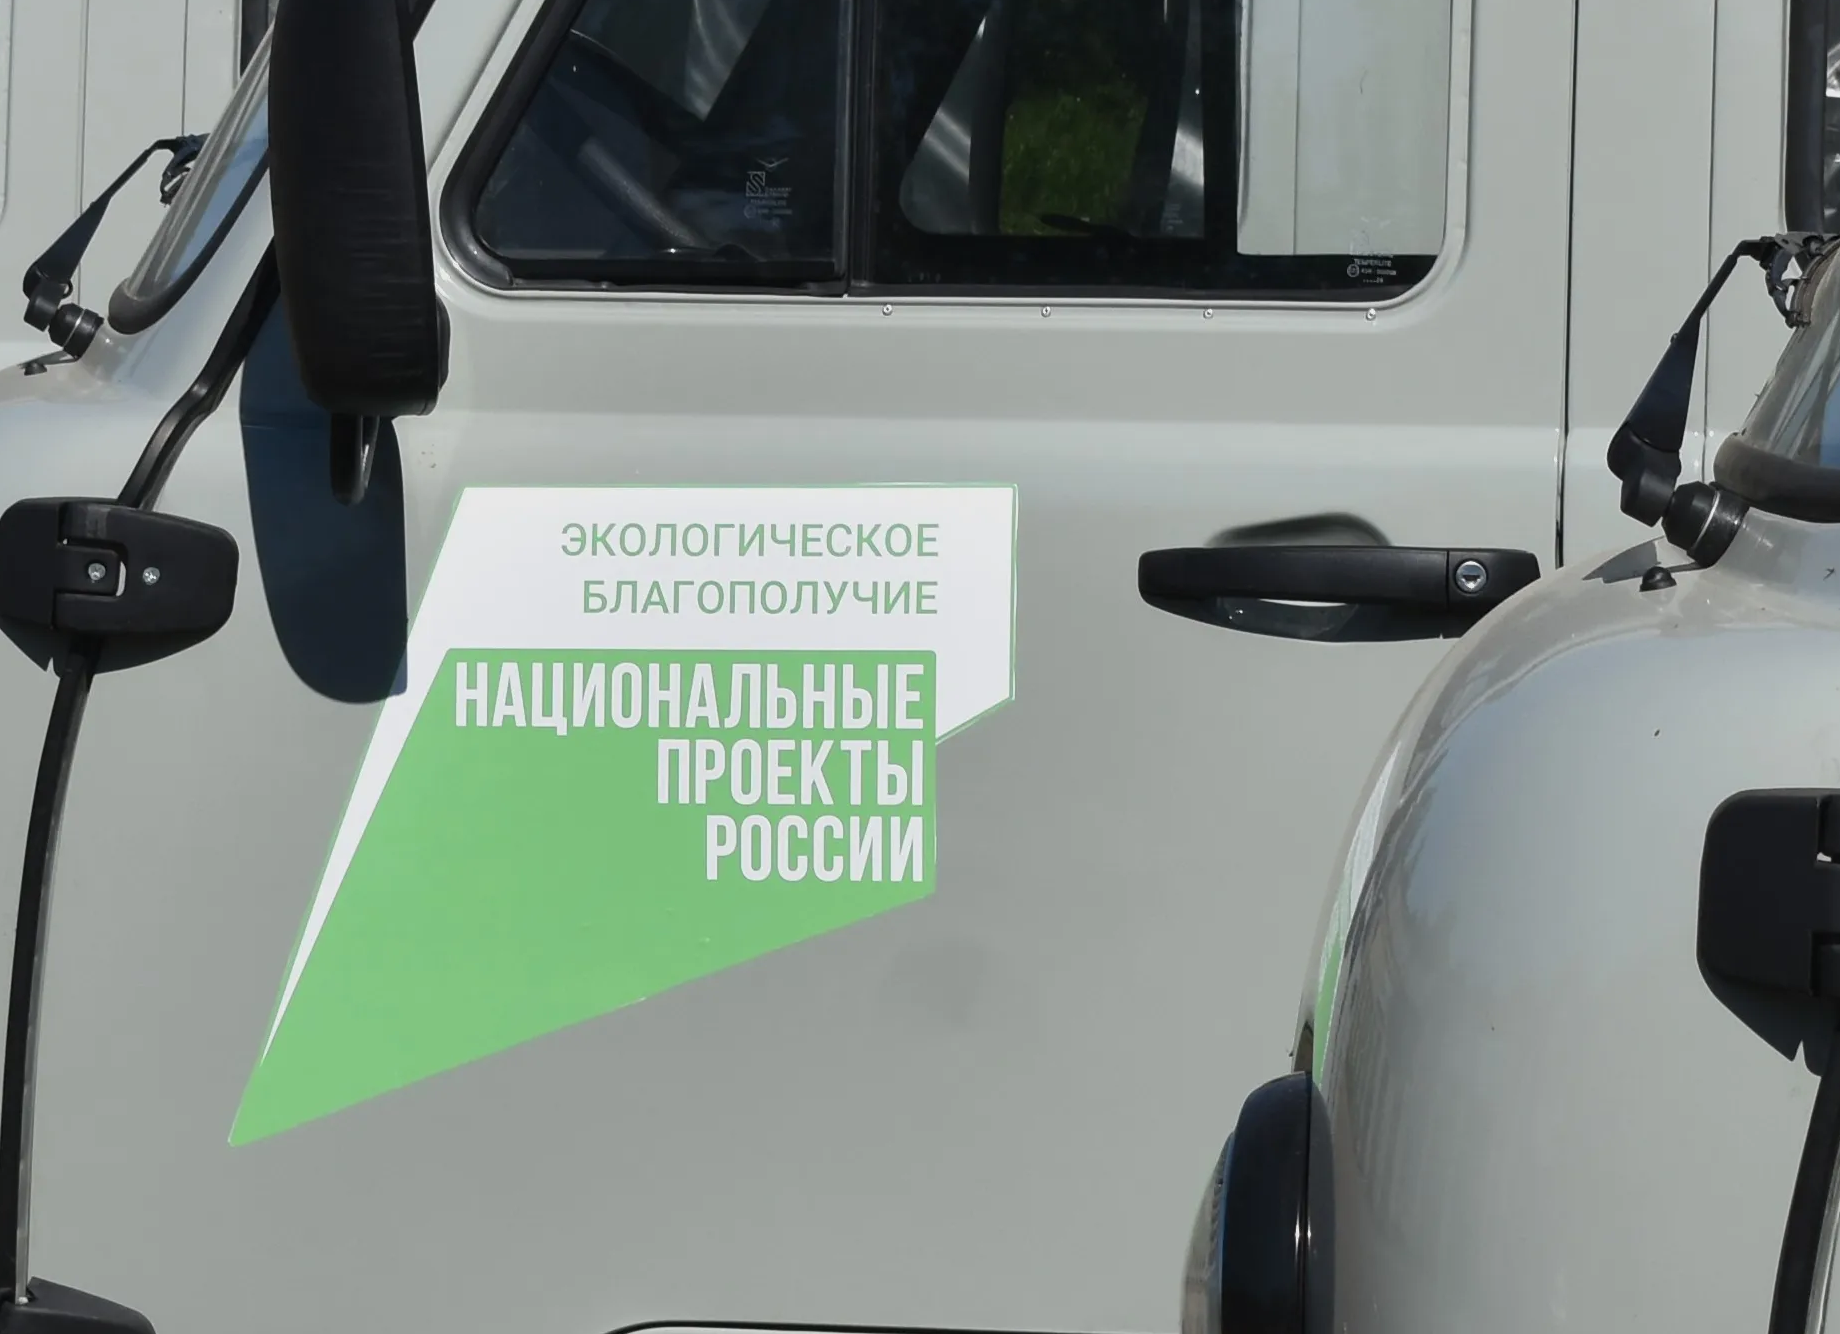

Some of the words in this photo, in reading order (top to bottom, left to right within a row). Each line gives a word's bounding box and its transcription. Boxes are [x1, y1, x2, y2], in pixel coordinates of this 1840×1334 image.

[560, 522, 941, 558] ЭКОЛОГИЧЕСКОЕ
[582, 579, 940, 616] БЛАГОПОЛУЧИЕ
[454, 661, 925, 736] НАЦИОНАЛЬНЫЕ
[656, 738, 925, 806] ПРОЕКТЫ
[705, 814, 924, 883] РОССИИ
